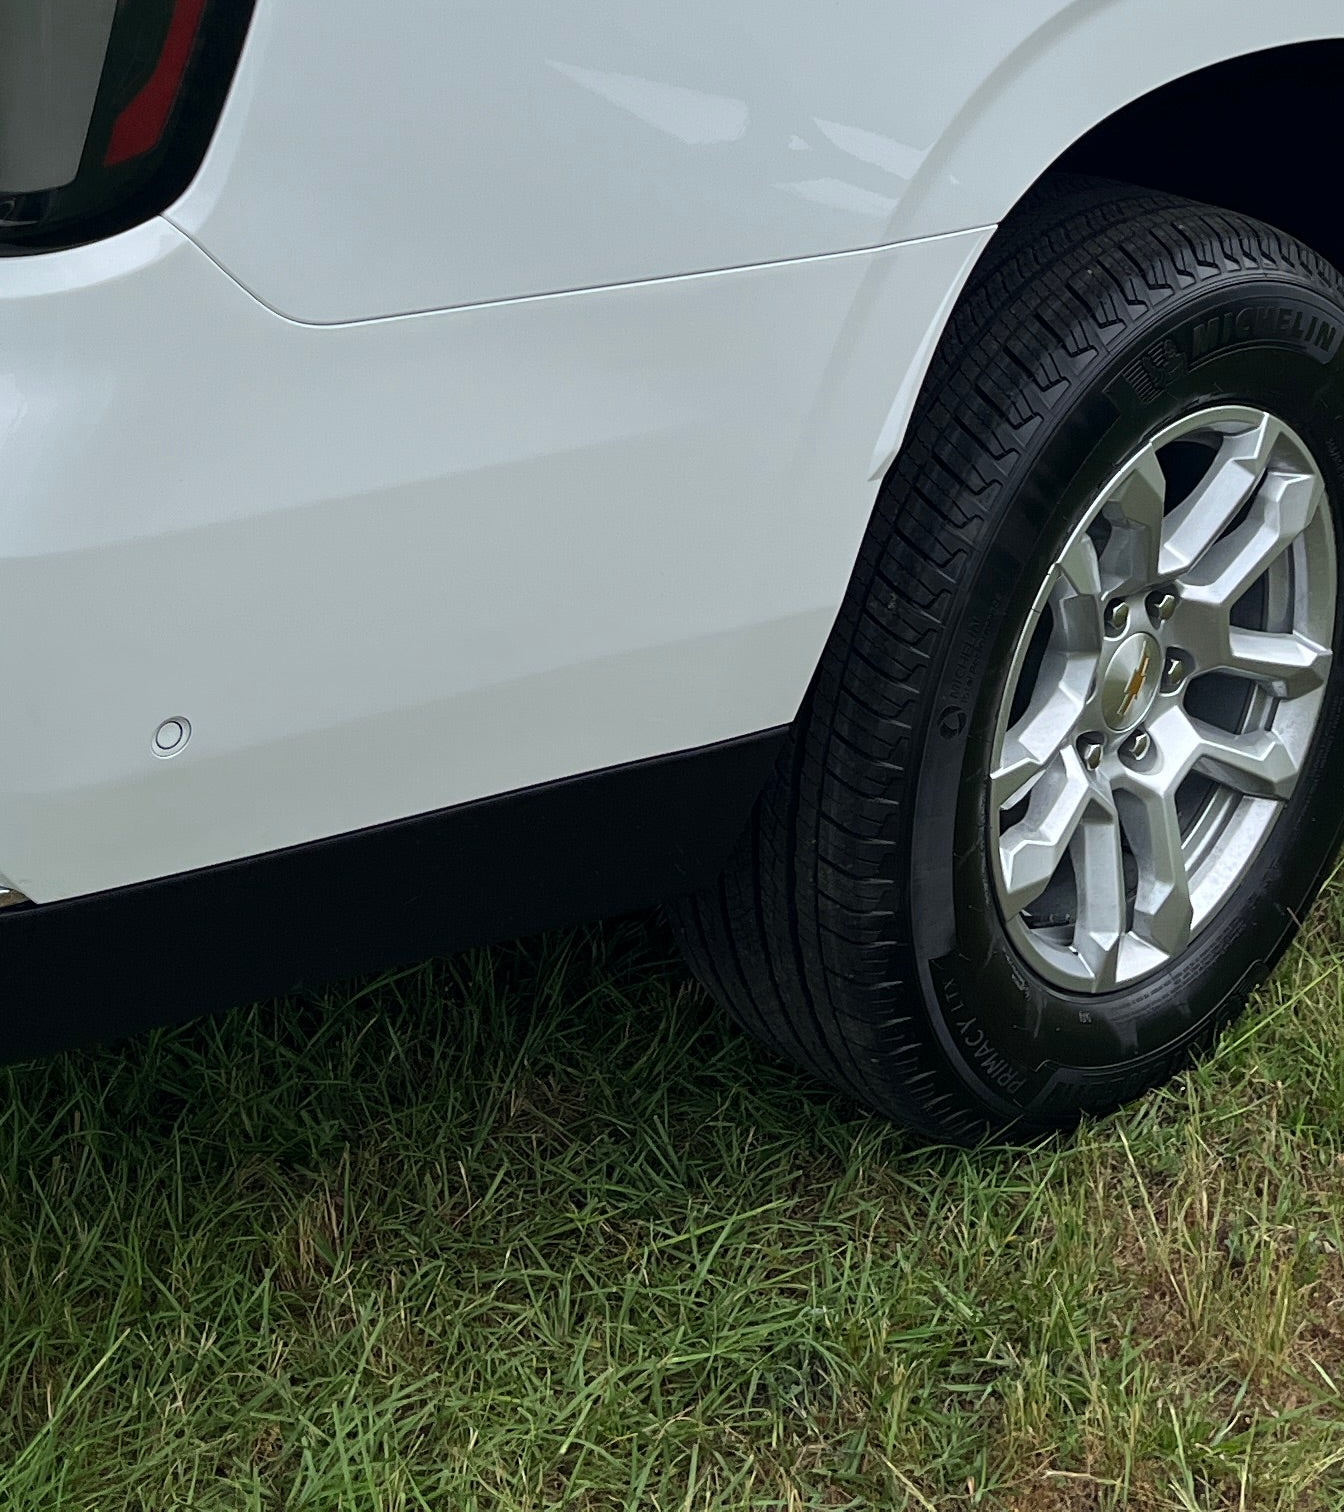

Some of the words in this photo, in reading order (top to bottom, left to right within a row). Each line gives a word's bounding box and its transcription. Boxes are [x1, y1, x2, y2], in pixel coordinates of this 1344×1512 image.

[1191, 305, 1338, 360] MICHELIN
[943, 976, 965, 1013] LTX
[956, 1016, 1027, 1095] PRIMACY
